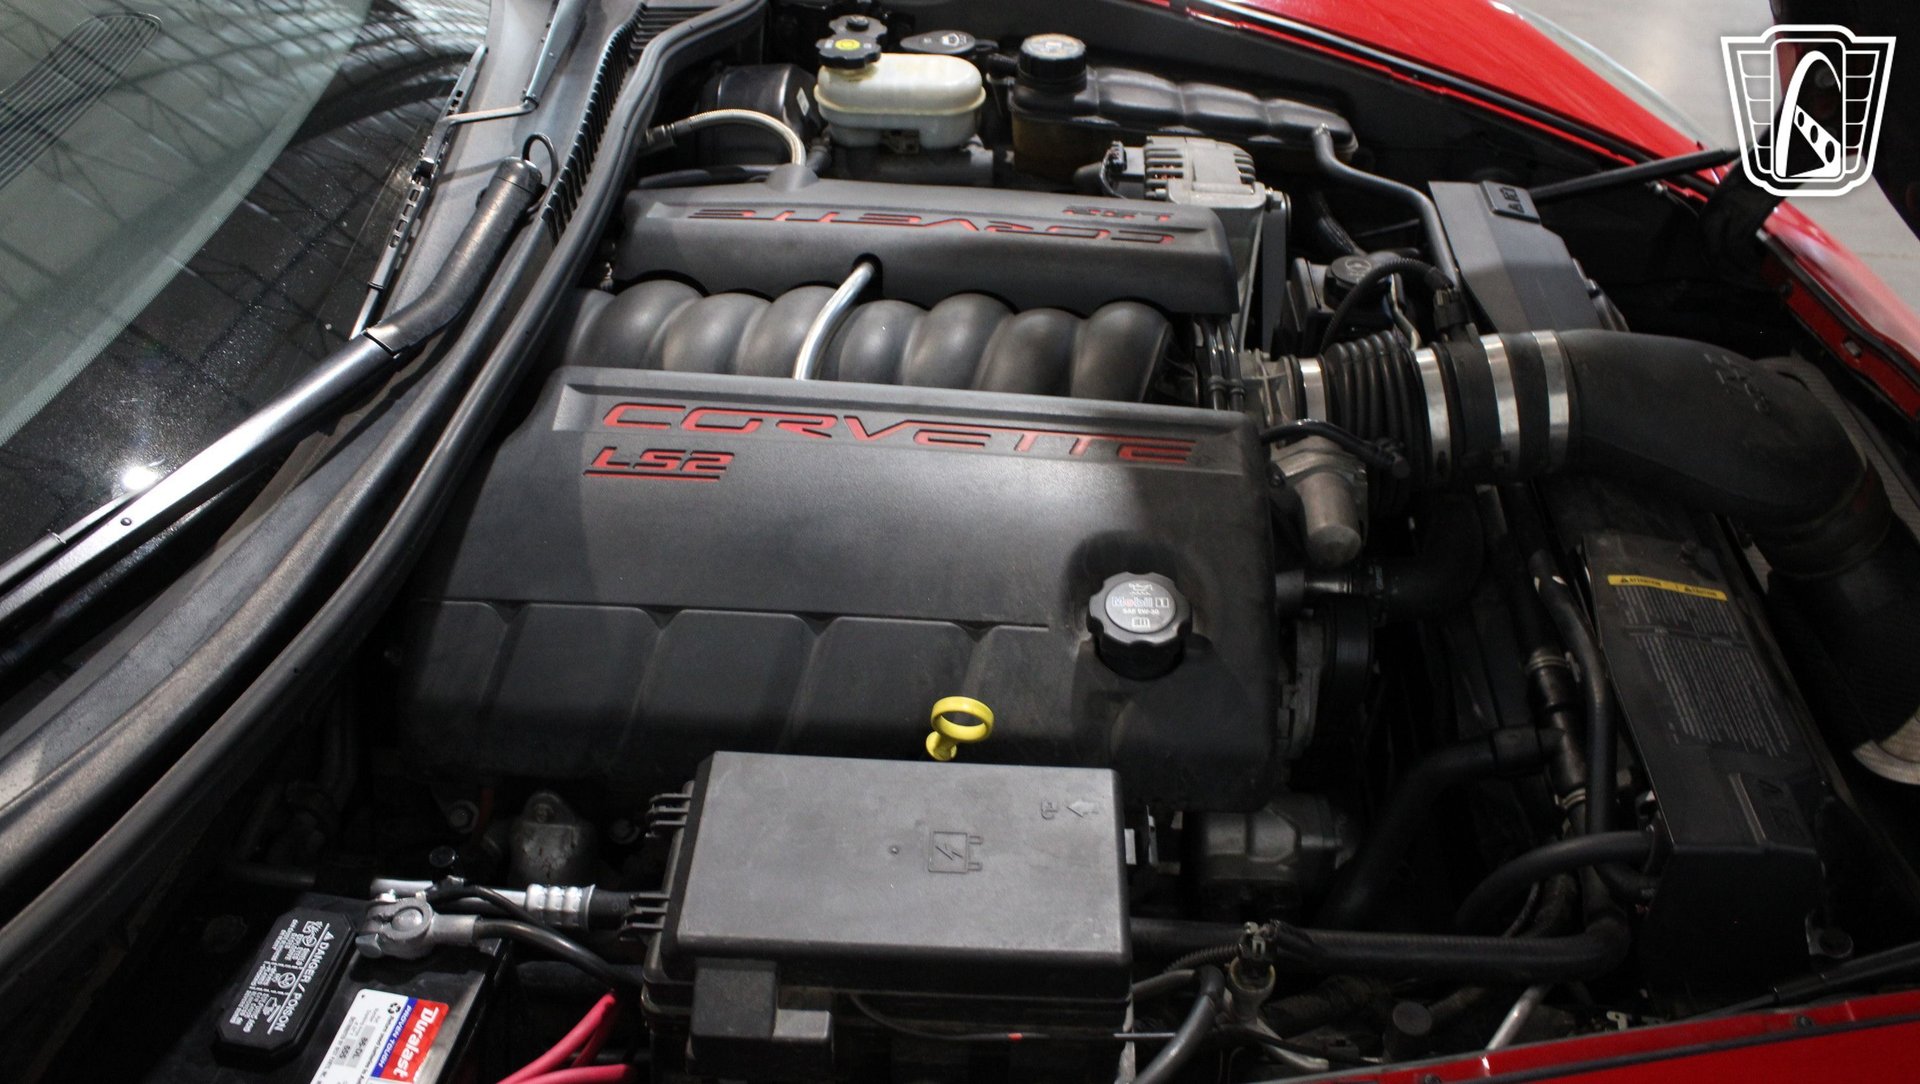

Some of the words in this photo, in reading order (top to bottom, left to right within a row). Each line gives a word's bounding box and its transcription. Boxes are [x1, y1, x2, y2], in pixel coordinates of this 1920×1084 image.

[688, 209, 1175, 243] CORVETTE
[603, 402, 1197, 464] CORVETTE
[590, 446, 735, 473] LS2
[1111, 596, 1153, 608] Mobil
[300, 941, 329, 983] DANGER
[273, 992, 302, 1031] POISON
[392, 1004, 412, 1038] PROVEN
[377, 1038, 396, 1068] TOUGH
[391, 1007, 440, 1078] Duralast
